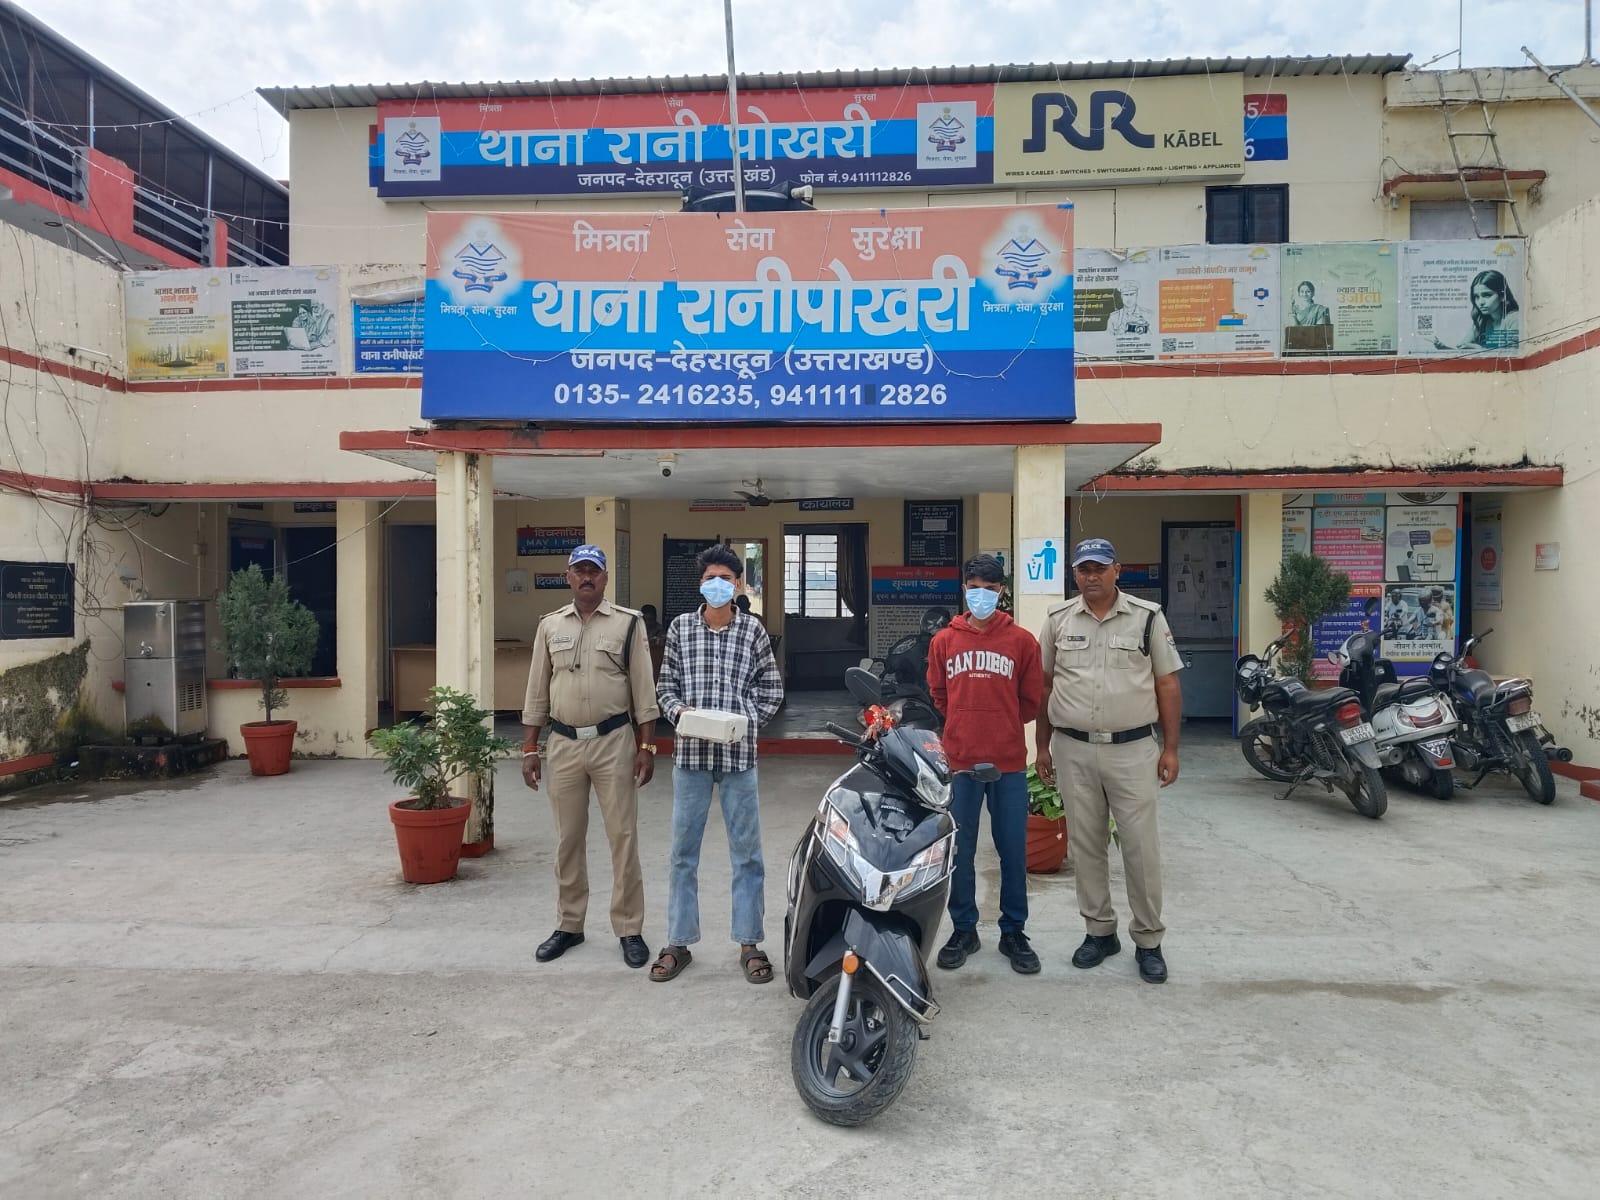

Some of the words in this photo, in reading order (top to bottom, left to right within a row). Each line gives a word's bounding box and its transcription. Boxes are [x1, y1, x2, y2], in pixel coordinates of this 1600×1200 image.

[478, 128, 590, 168] थाना
[603, 108, 707, 166] रानी
[723, 103, 877, 161] पोखरी
[1163, 130, 1223, 149] KĀBEL
[577, 167, 692, 189] जनपद-देहरादून
[800, 171, 824, 184] फोन
[572, 219, 649, 253] मित्रता
[724, 218, 776, 251] सेवा
[850, 225, 924, 260] सुरक्षा
[531, 281, 664, 333] थाना
[676, 254, 976, 336] रानीपोखरी
[440, 302, 469, 316] मित्रता,
[471, 302, 491, 316] सेवा,
[494, 302, 518, 318] सुरक्षा
[982, 301, 1013, 314] मित्रता,
[1016, 301, 1036, 313] सेवा,
[1039, 300, 1064, 316] सुरक्षा
[570, 340, 773, 379] जनपद-देहरादून
[783, 343, 934, 376] (उत्तराखण्ड)
[554, 383, 630, 405] 0135-
[637, 383, 761, 409] 2416235,
[526, 538, 549, 546] MAY
[946, 650, 974, 680] SAN
[975, 650, 1015, 680] DIEGO
